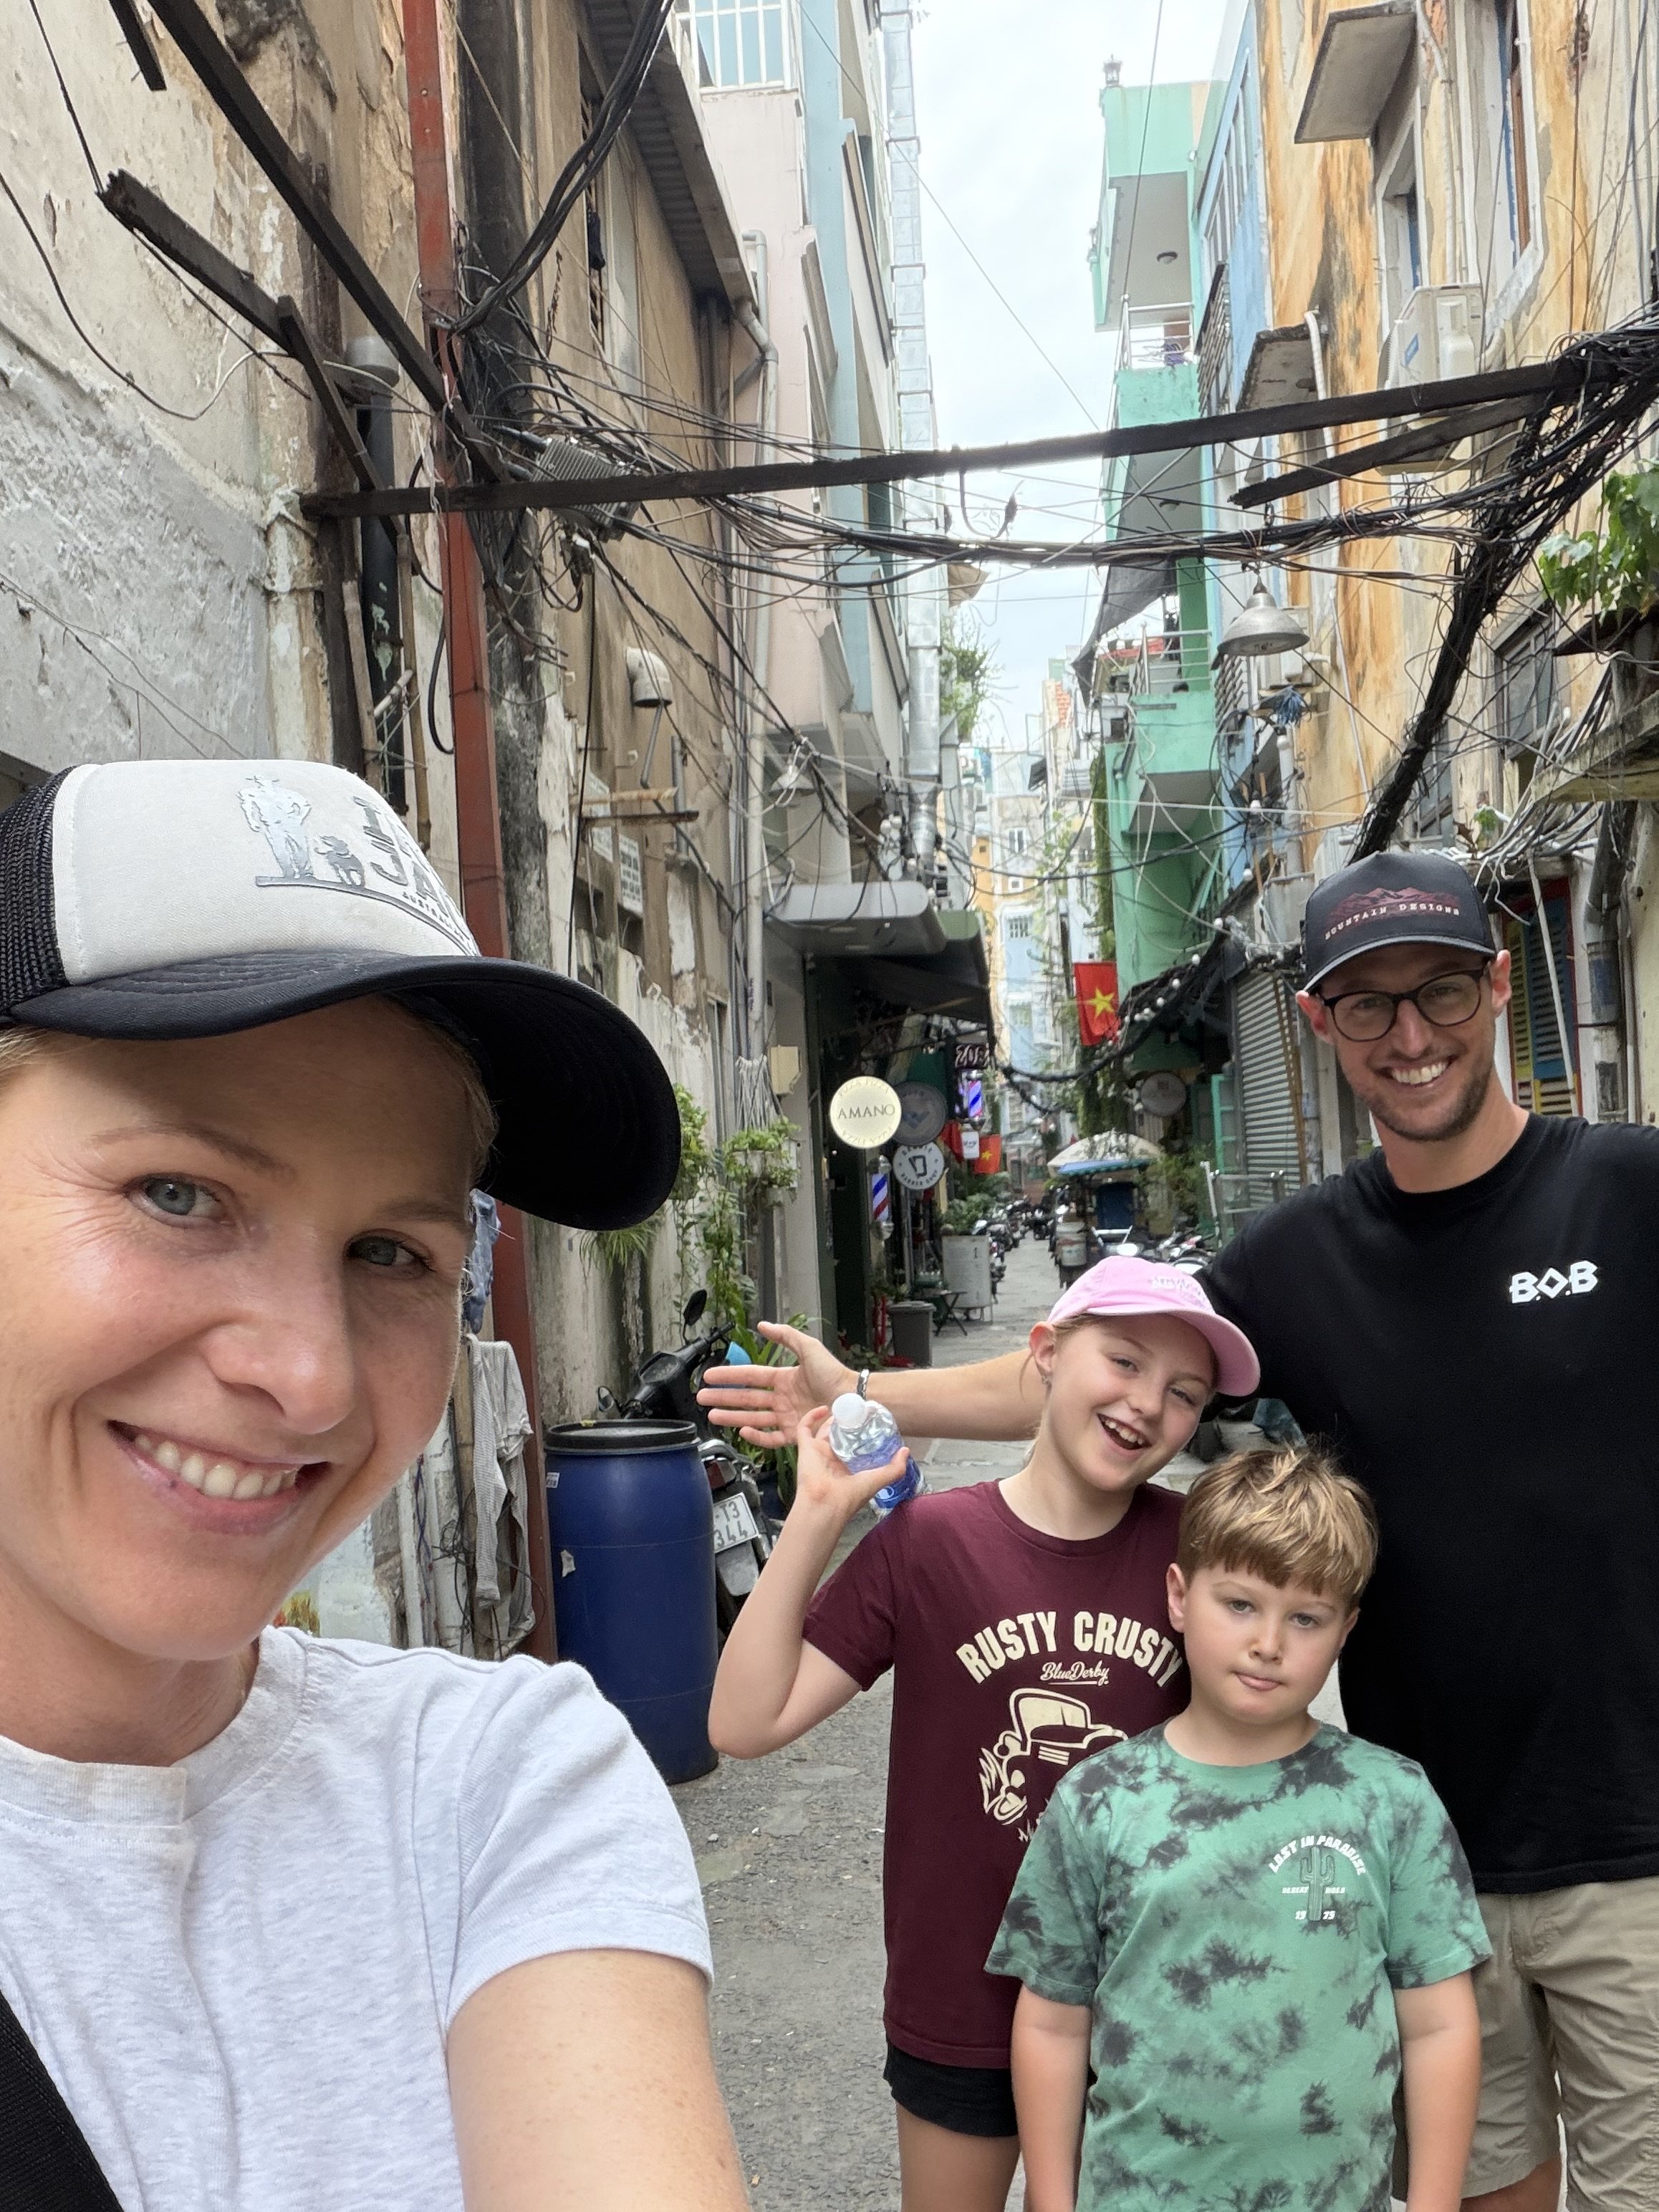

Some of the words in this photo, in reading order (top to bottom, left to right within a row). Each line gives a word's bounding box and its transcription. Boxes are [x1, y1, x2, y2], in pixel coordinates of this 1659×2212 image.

[1324, 905, 1388, 941] MOUNTAIN
[1398, 903, 1460, 916] DESIGNS
[837, 1104, 895, 1119] AMANO
[1509, 1260, 1598, 1304] B.O.B
[956, 1611, 1057, 1684] RUSTY
[1073, 1611, 1183, 1688] CRUSTY
[1268, 1840, 1298, 1873] LOST
[1300, 1835, 1315, 1849] IN
[1316, 1834, 1366, 1875] PARADISE
